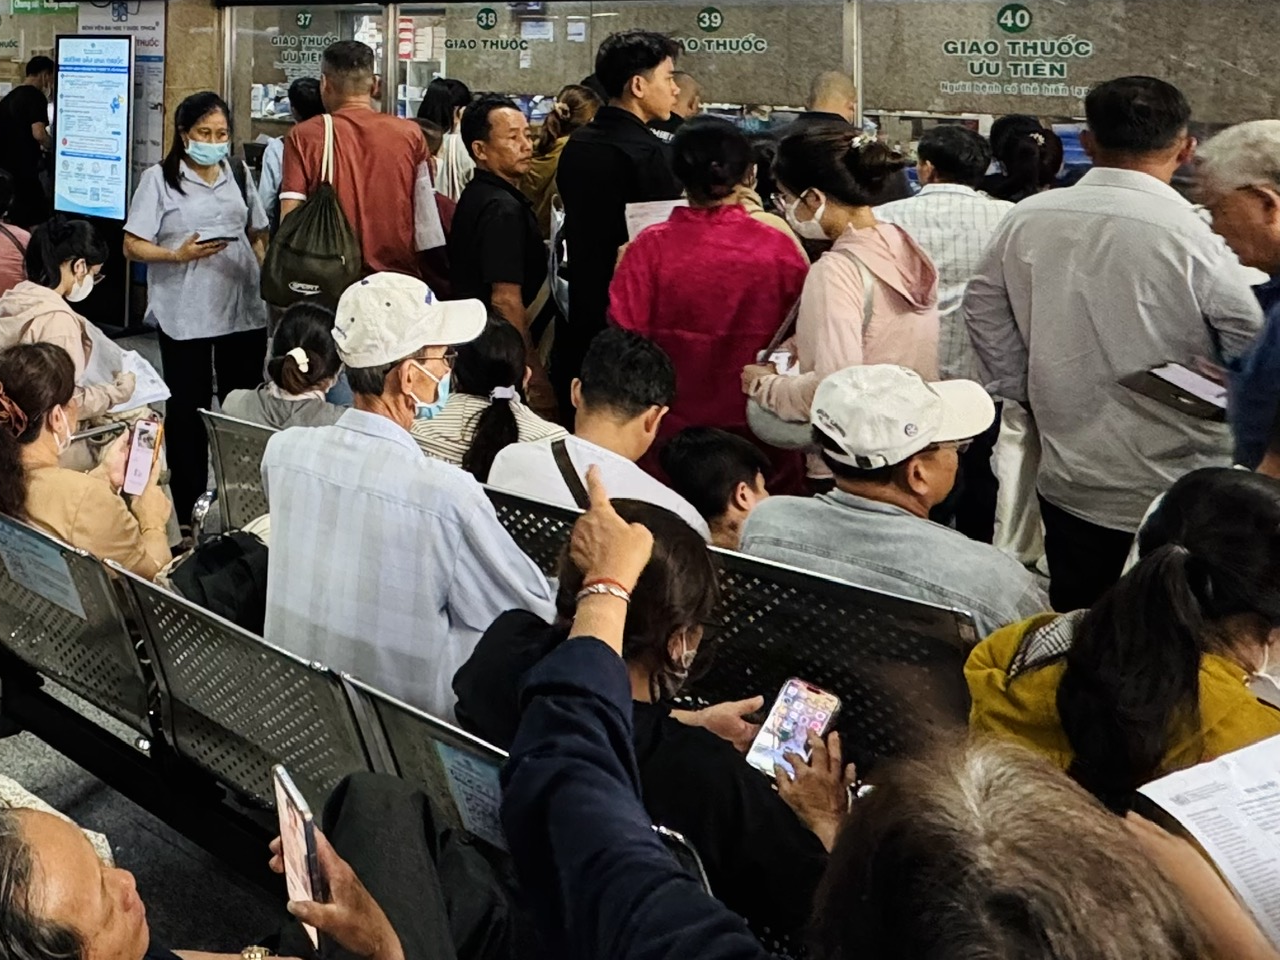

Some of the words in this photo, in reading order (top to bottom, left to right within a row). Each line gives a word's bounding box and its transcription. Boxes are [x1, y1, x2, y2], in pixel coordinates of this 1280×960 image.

[297, 13, 312, 26] 37
[478, 12, 496, 26] 38
[699, 12, 722, 28] 39
[999, 9, 1030, 28] 40
[271, 36, 298, 46] GIAO
[444, 38, 477, 50] GIAO
[704, 33, 767, 53] THUỐC
[943, 39, 1000, 56] GIAO
[1007, 34, 1093, 58] THUỐC
[968, 58, 1001, 77] ƯU
[1007, 58, 1068, 78] TIÊN
